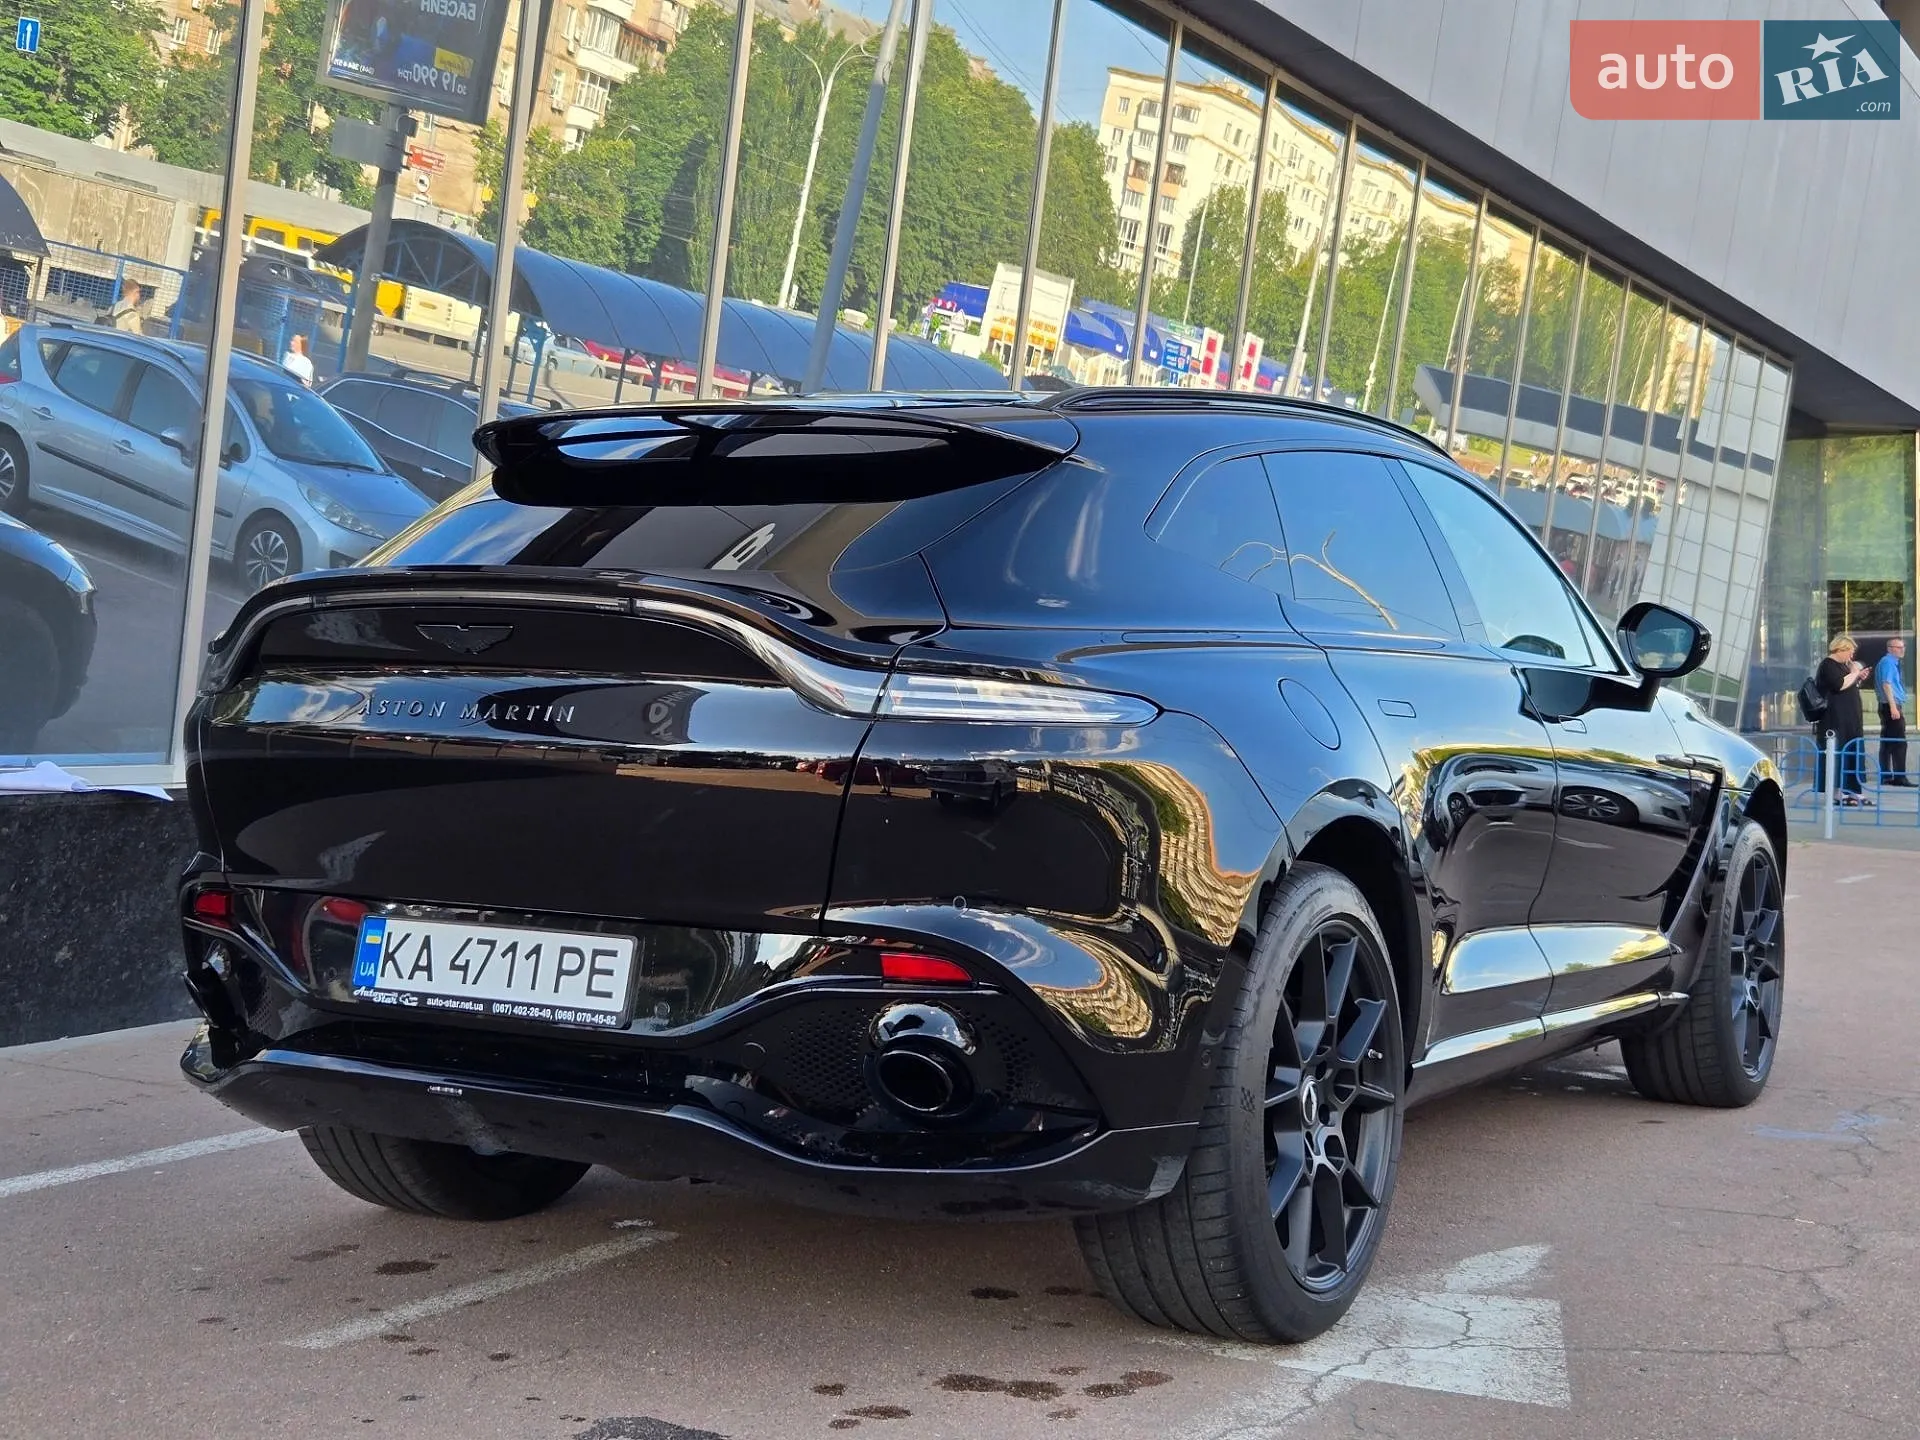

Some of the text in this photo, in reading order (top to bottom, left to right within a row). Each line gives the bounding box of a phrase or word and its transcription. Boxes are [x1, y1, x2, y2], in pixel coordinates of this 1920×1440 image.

[358, 698, 574, 724] ASTON MARTIN
[360, 961, 375, 977] UA
[380, 931, 619, 999] KA 4711 PE
[426, 997, 484, 1012] auto-star.net.ua
